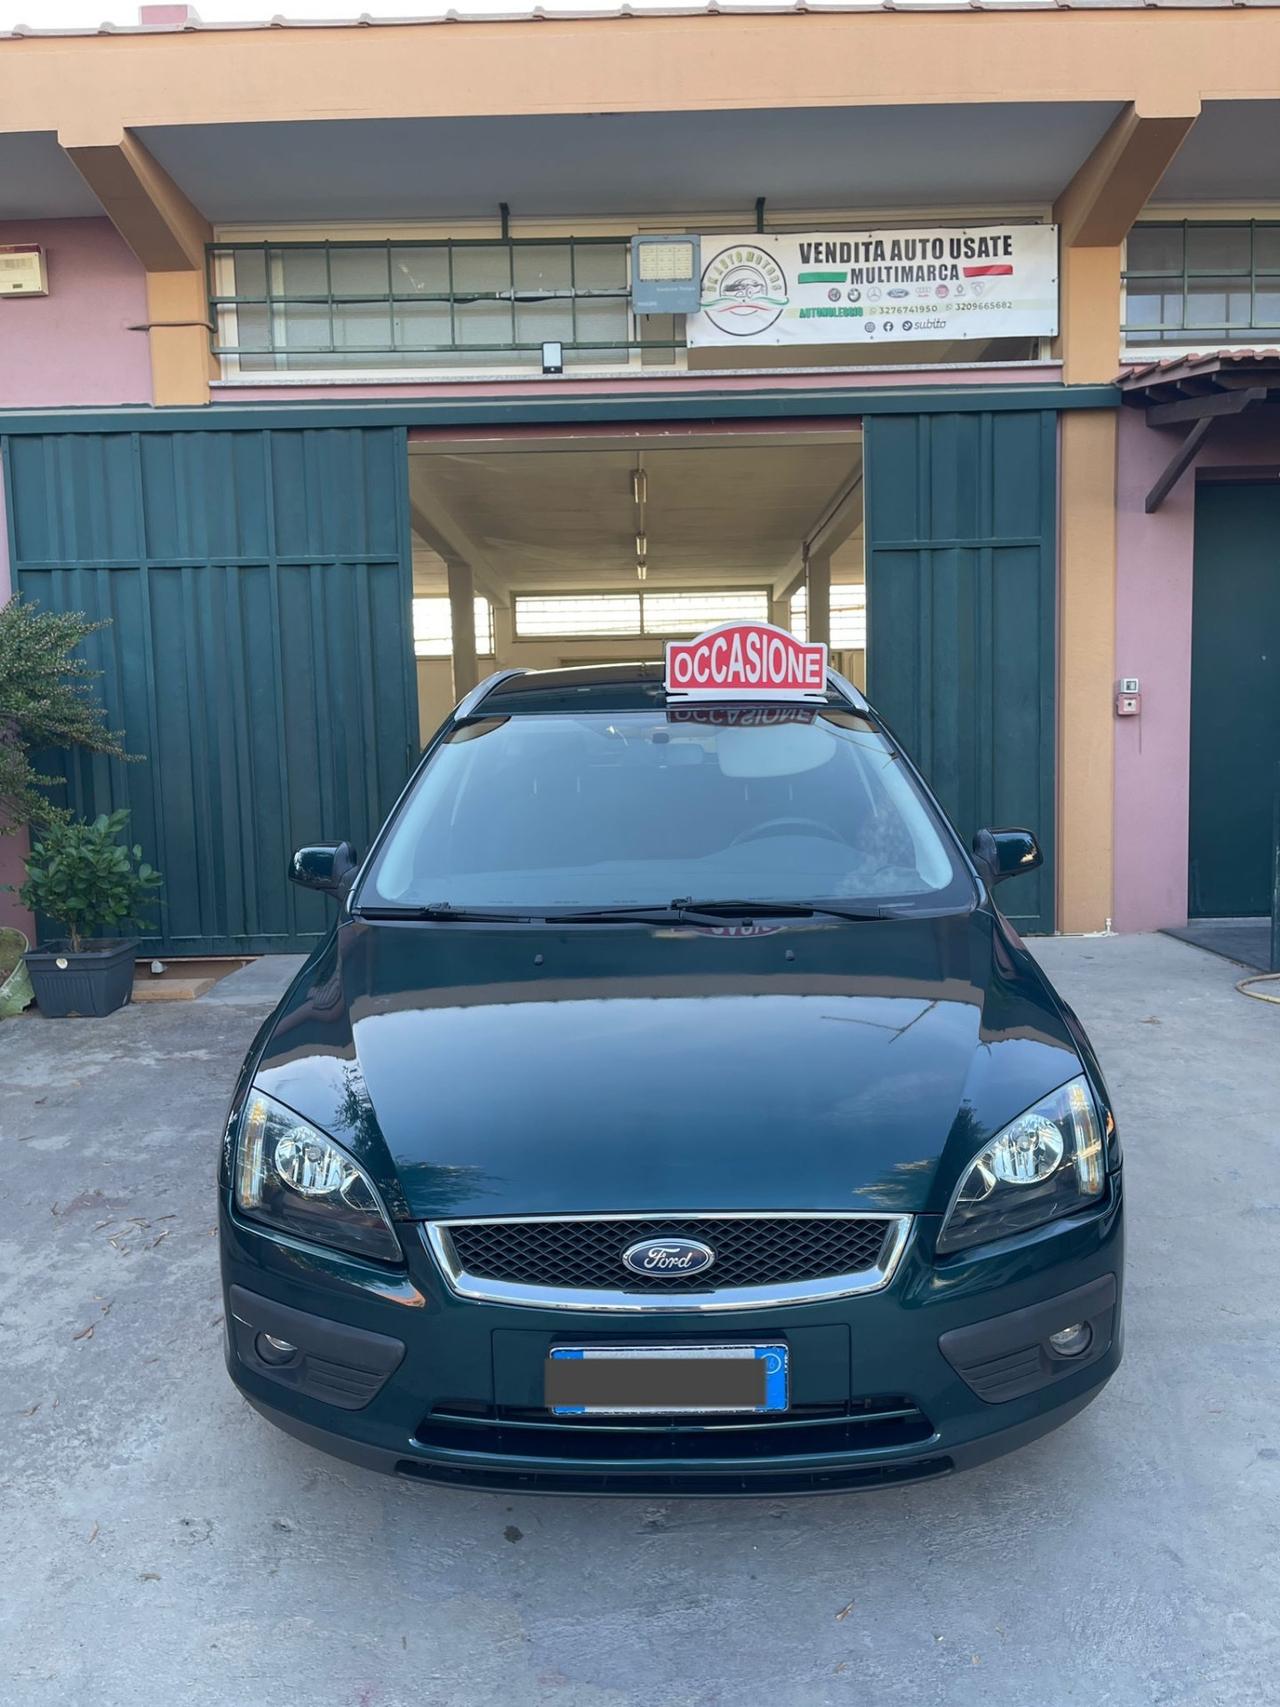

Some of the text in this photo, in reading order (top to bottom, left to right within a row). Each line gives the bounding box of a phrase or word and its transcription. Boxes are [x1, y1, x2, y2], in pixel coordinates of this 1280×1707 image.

[798, 235, 1013, 264] VENDITA AUTO USATE
[850, 264, 959, 285] MULTIMARCA
[914, 318, 947, 330] subito
[673, 631, 821, 684] OCCASIONE
[643, 1247, 693, 1269] Ford
